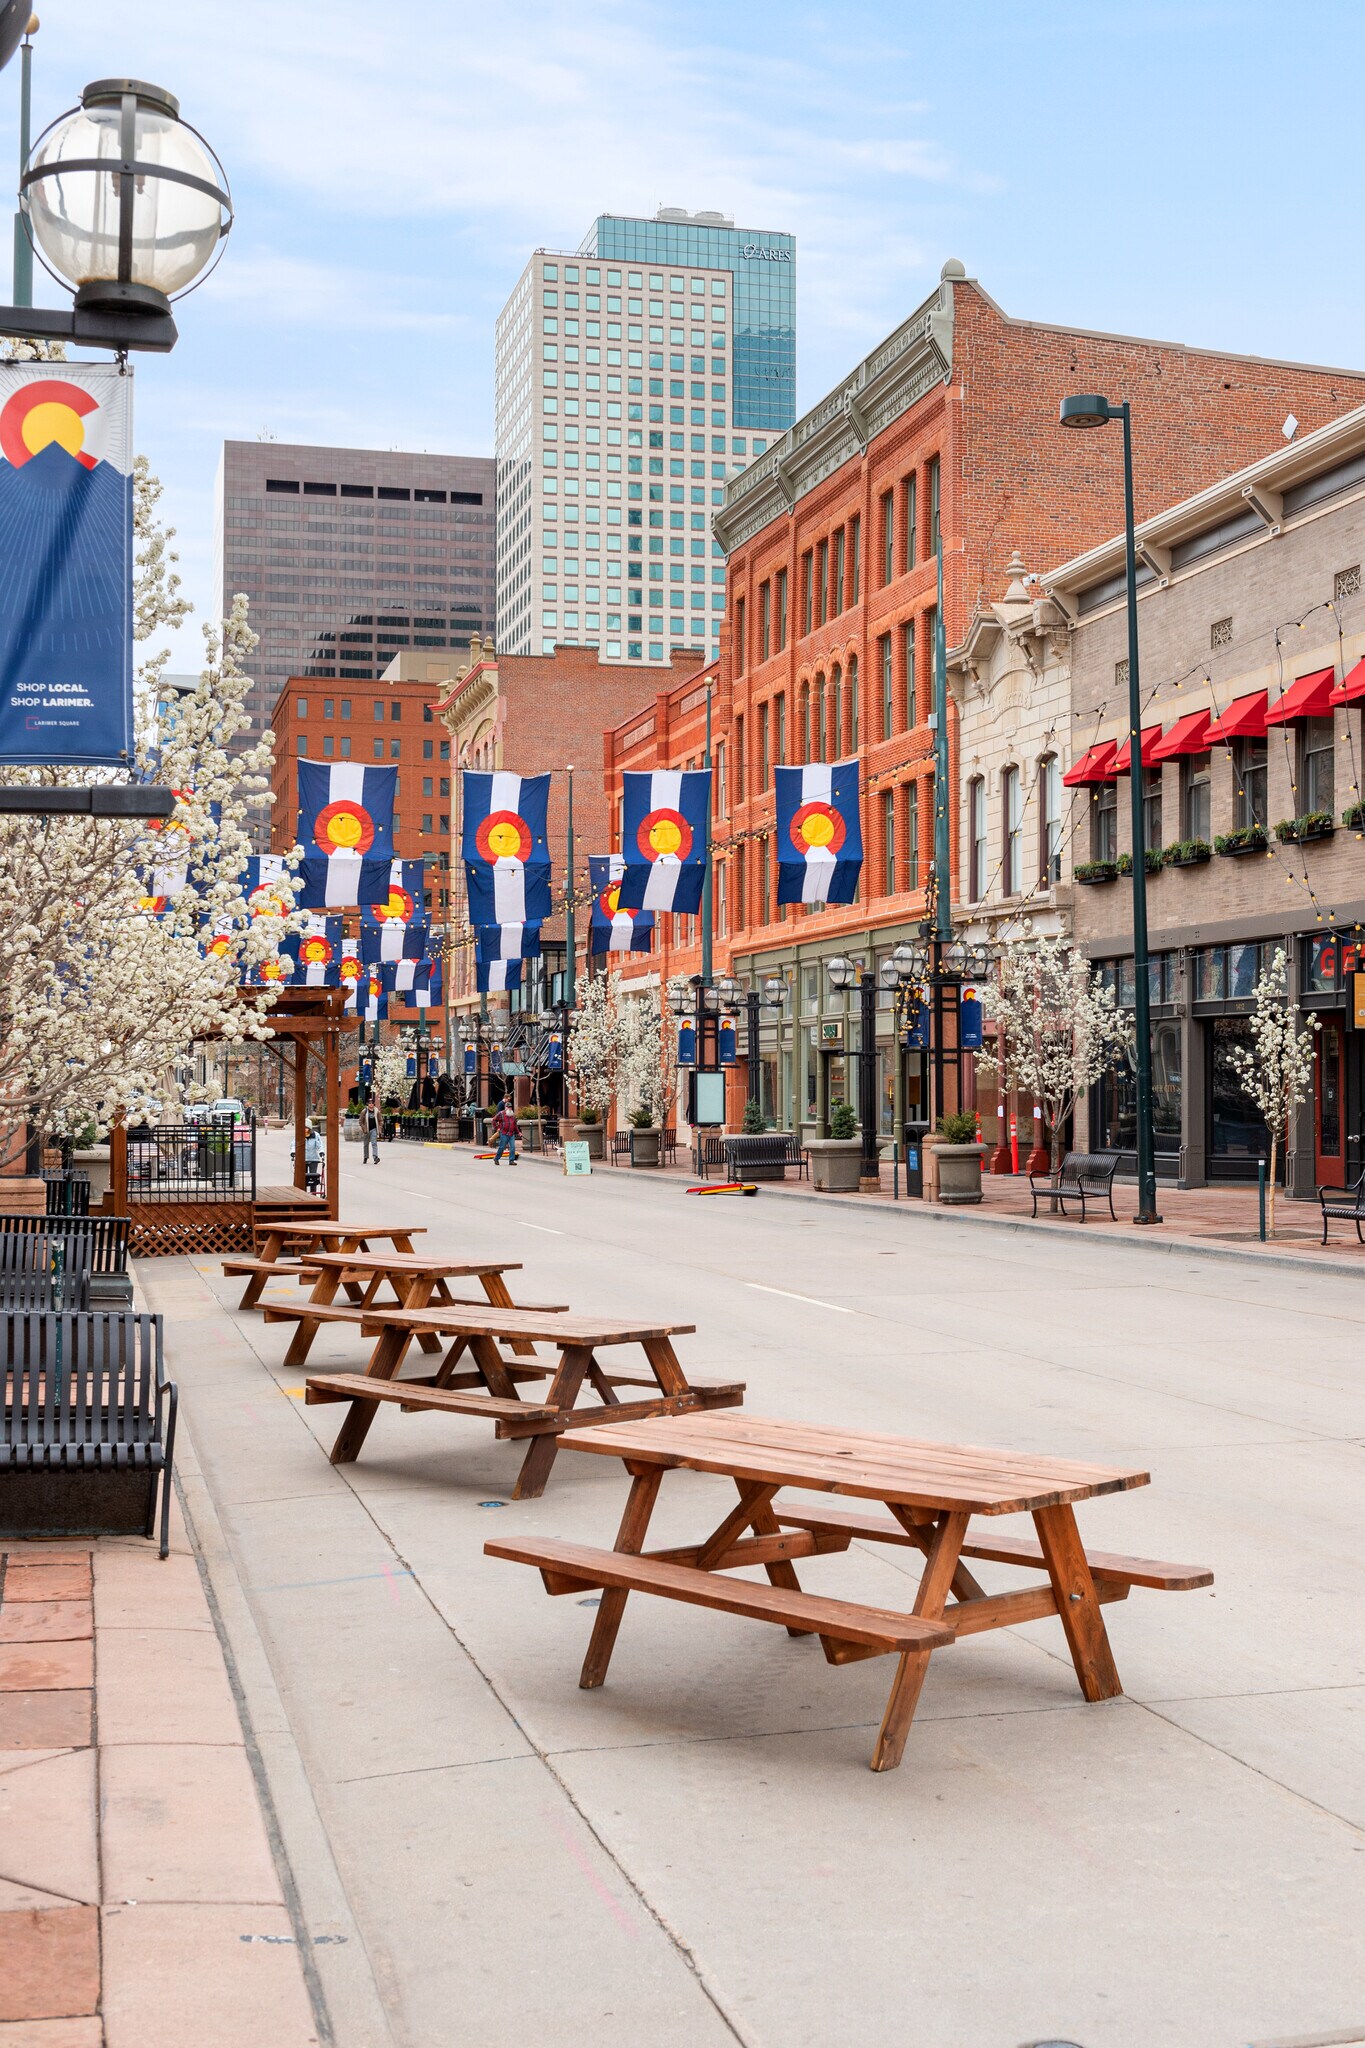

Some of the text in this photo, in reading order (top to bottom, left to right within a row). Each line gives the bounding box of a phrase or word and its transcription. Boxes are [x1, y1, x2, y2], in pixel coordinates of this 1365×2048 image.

[758, 248, 790, 261] ARES
[16, 682, 88, 692] SHOP LOCAL.
[10, 697, 94, 707] SHOP LARIMER.
